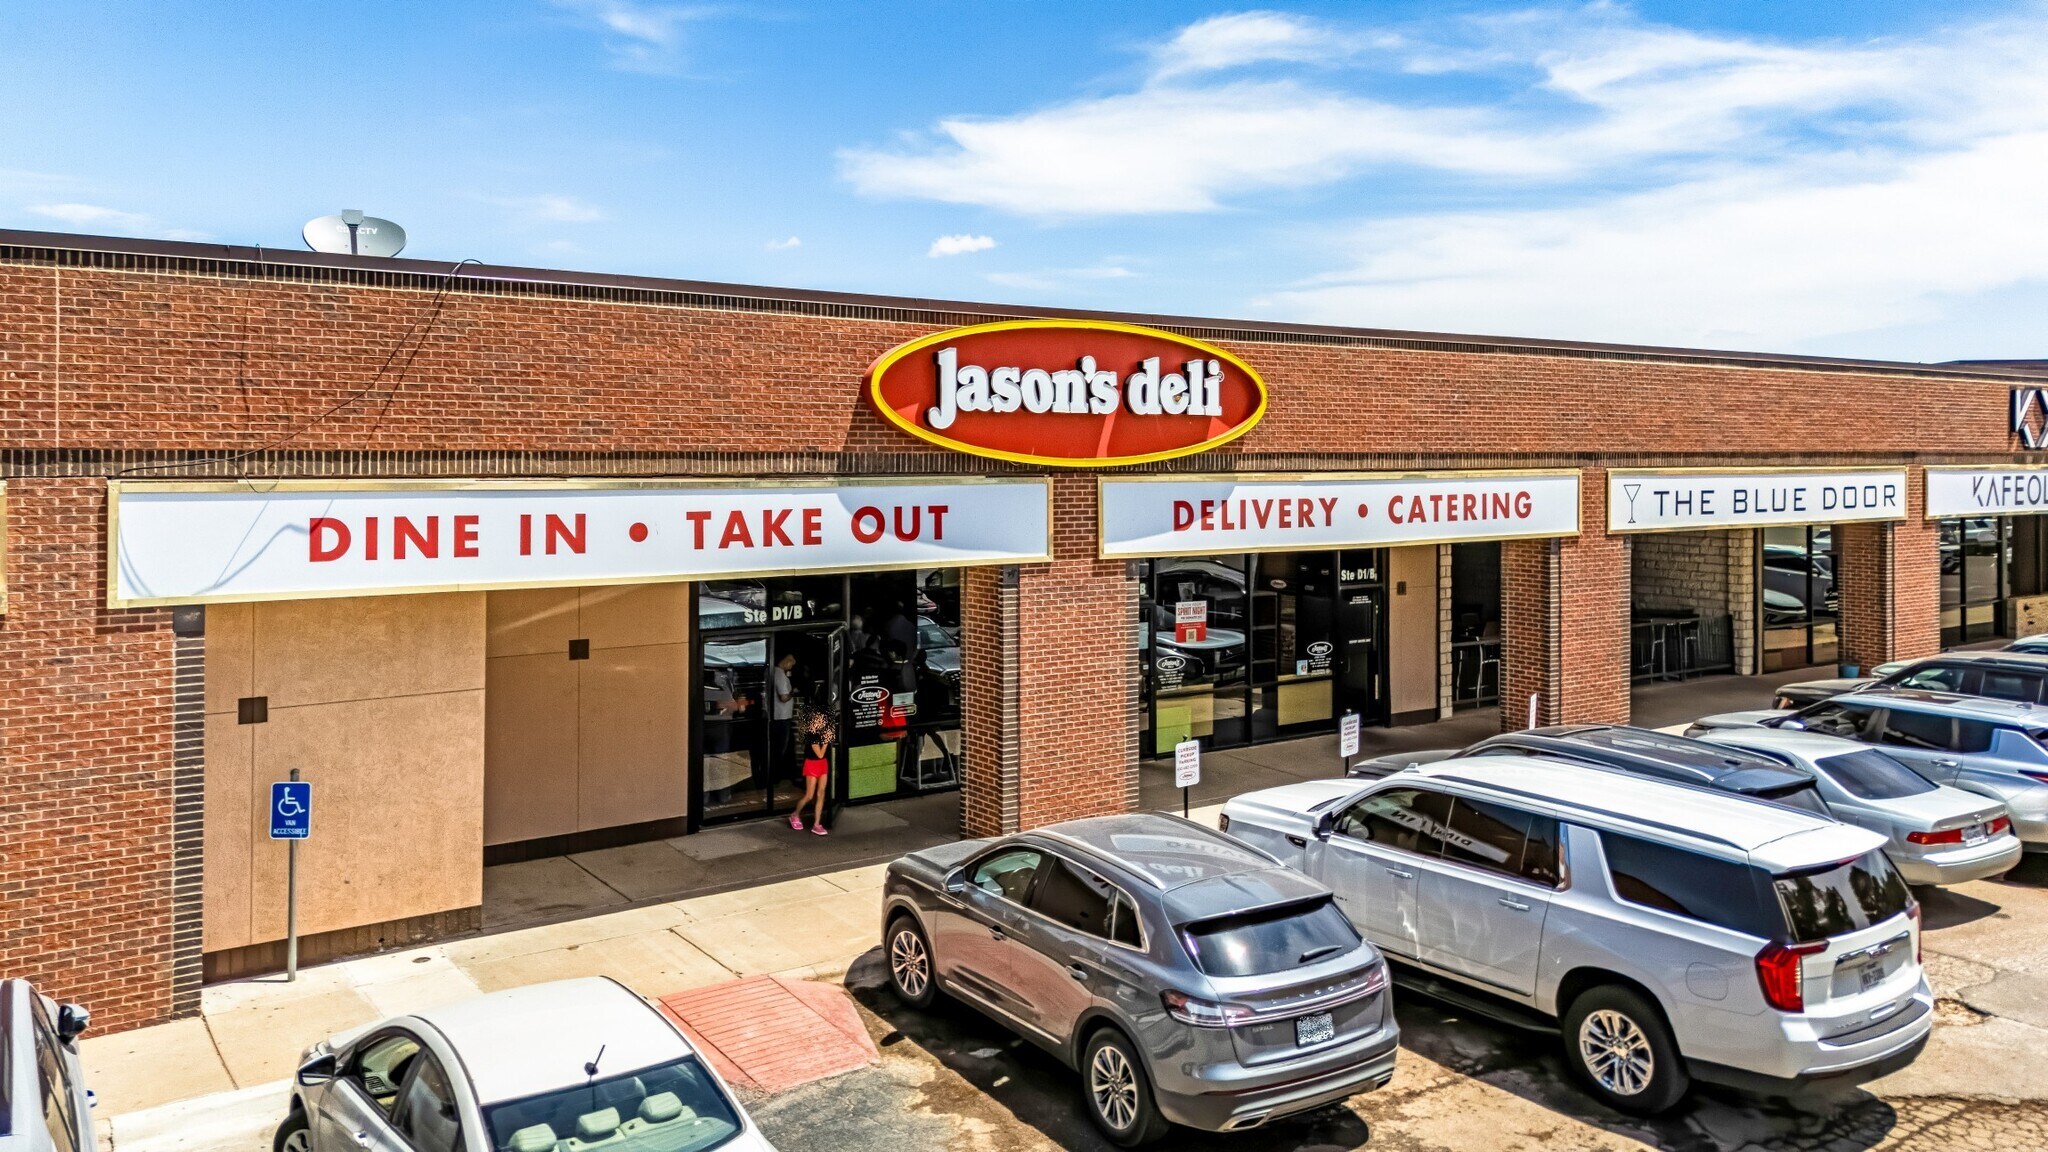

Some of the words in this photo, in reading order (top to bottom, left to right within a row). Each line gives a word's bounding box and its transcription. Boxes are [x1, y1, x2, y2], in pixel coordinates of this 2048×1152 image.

[928, 346, 1119, 430] Jason's
[1127, 355, 1224, 417] deli
[1173, 497, 1339, 532] DELIVERY
[1388, 491, 1531, 524] CATERING
[1653, 490, 1715, 517] THE
[1733, 487, 1807, 514] BLUE
[1822, 484, 1896, 511] DOOR
[308, 514, 481, 563] DINE
[519, 513, 587, 556] IN
[686, 507, 822, 550] TAKE
[850, 504, 949, 545] OUT
[1340, 569, 1355, 581] Ste
[743, 608, 767, 624] Ste
[772, 604, 803, 621] D1/B
